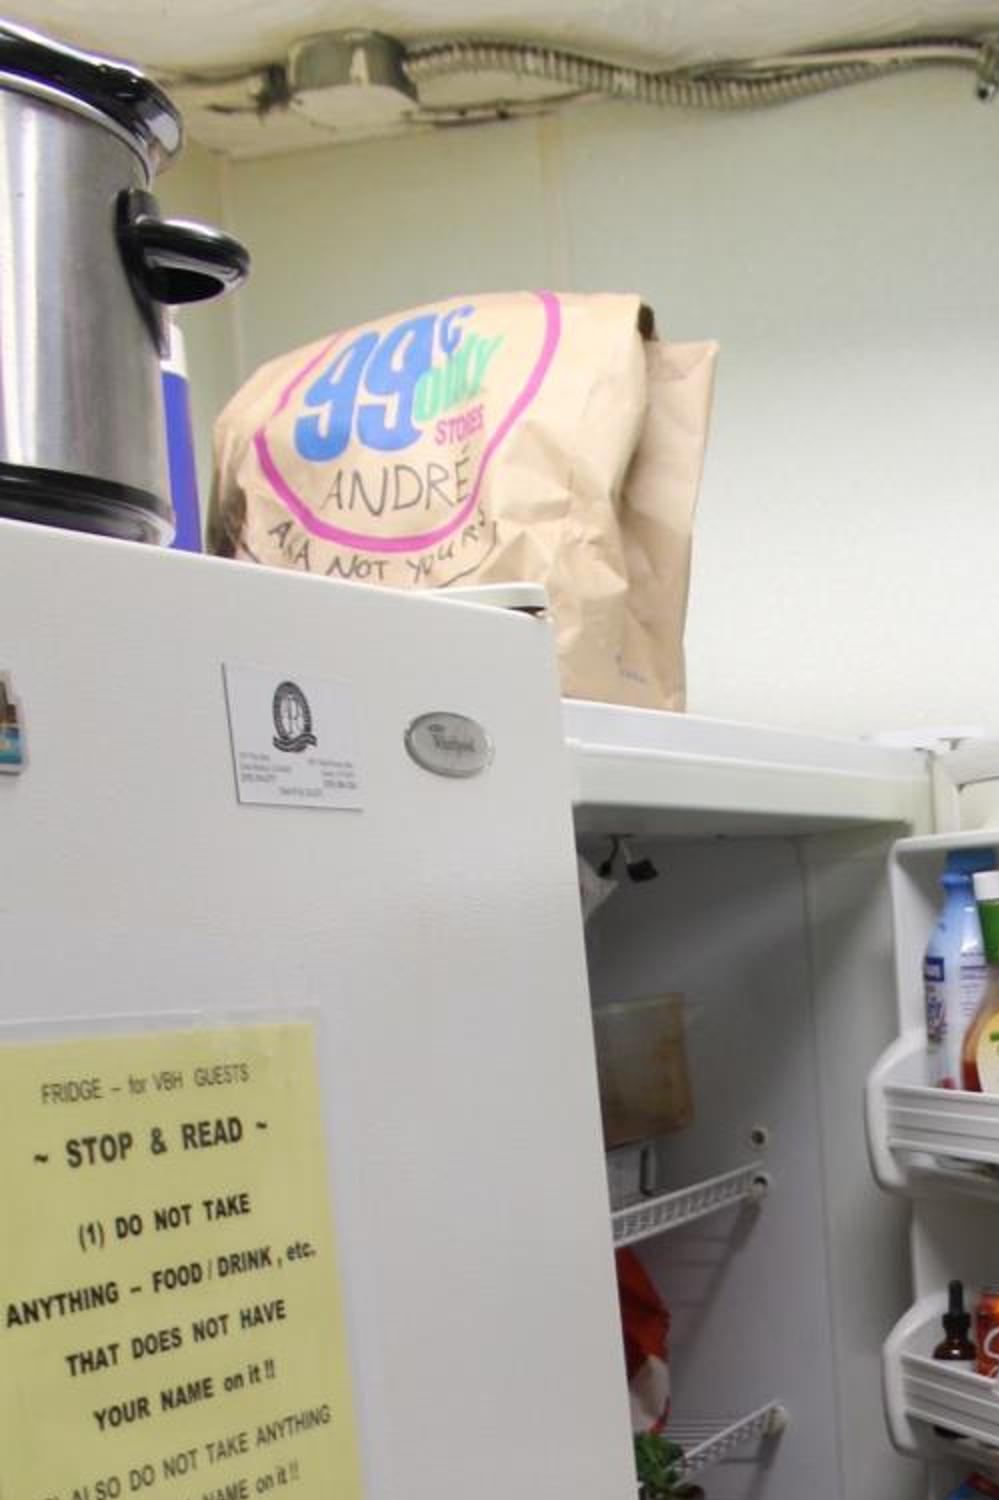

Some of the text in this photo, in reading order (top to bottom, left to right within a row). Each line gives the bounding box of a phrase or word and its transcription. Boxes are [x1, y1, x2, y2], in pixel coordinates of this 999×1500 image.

[325, 555, 389, 580] NOT
[41, 1078, 103, 1104] FRIDGE
[128, 1074, 148, 1094] for
[194, 1063, 250, 1088] GUESTS
[65, 1132, 133, 1168] STOP
[151, 1127, 168, 1155] &
[181, 1116, 243, 1150] READ
[78, 1193, 251, 1251] (1) DO NOT TAKE
[5, 1281, 120, 1328] ANYTHING
[66, 1299, 287, 1377] THAT DOES NOT HAVE
[93, 1397, 151, 1432] YOUR
[160, 1377, 214, 1411] NAME
[223, 1374, 244, 1392] on
[128, 1464, 155, 1492] DO
[162, 1449, 199, 1479] NOT
[205, 1432, 249, 1464] TAKE
[256, 1404, 332, 1447] ANYTHING
[256, 1476, 274, 1494] on
